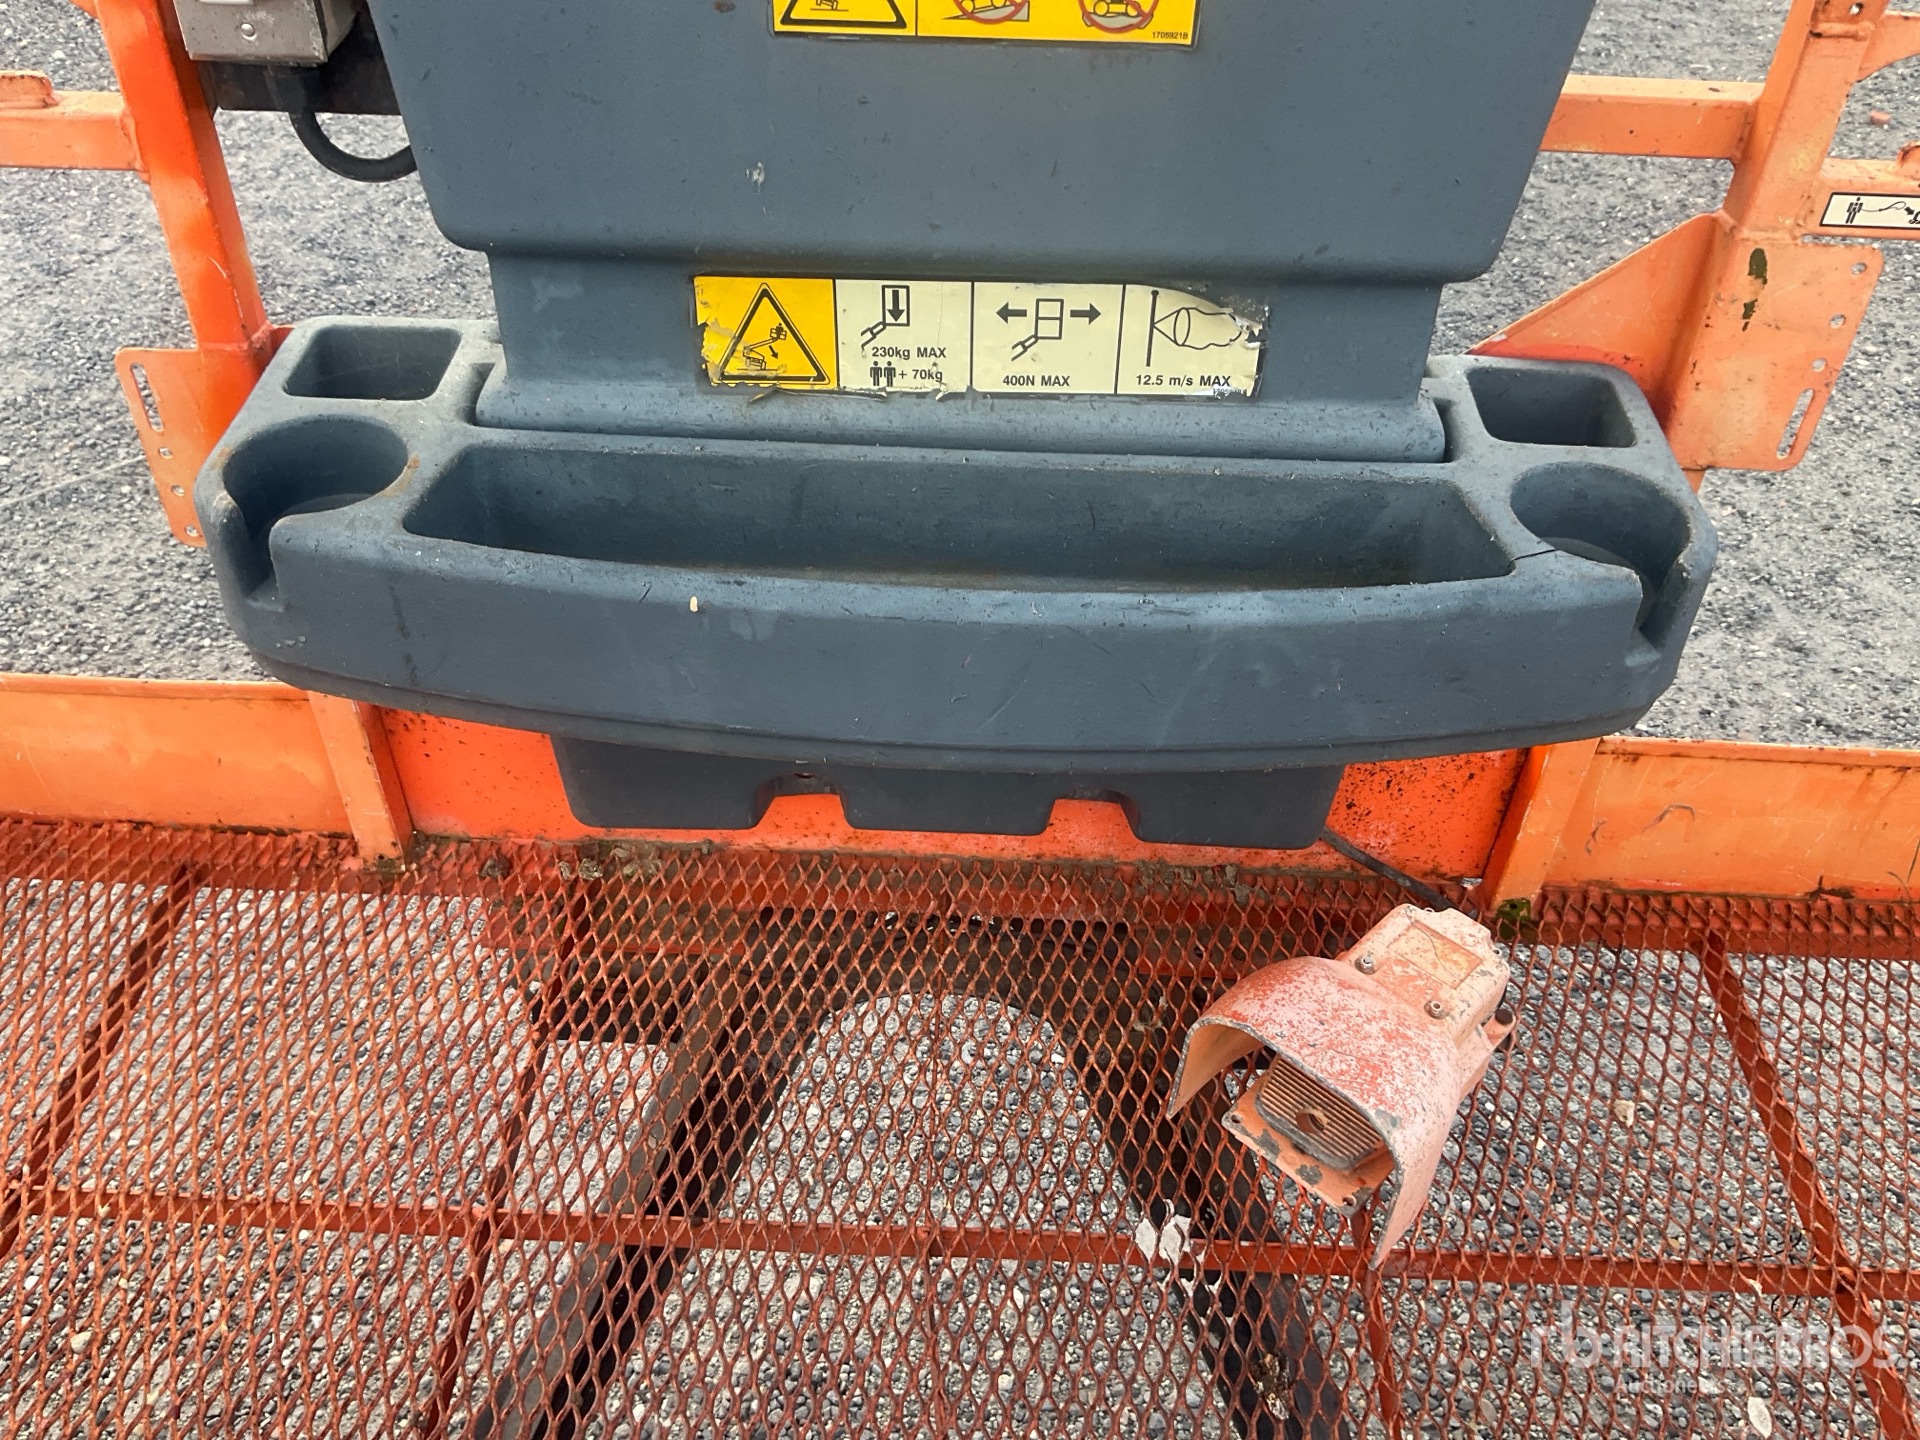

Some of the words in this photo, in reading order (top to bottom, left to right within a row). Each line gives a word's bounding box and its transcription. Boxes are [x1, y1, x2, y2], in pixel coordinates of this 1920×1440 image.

[1152, 31, 1189, 39] 1705921B
[872, 346, 911, 360] 230kg
[916, 347, 947, 358] MAX
[912, 369, 943, 382] 70kg
[1003, 375, 1035, 386] 400N
[1041, 375, 1071, 387] MAX
[1136, 374, 1164, 386] 12.5
[1169, 375, 1194, 387] m/s
[1199, 375, 1231, 387] MAX
